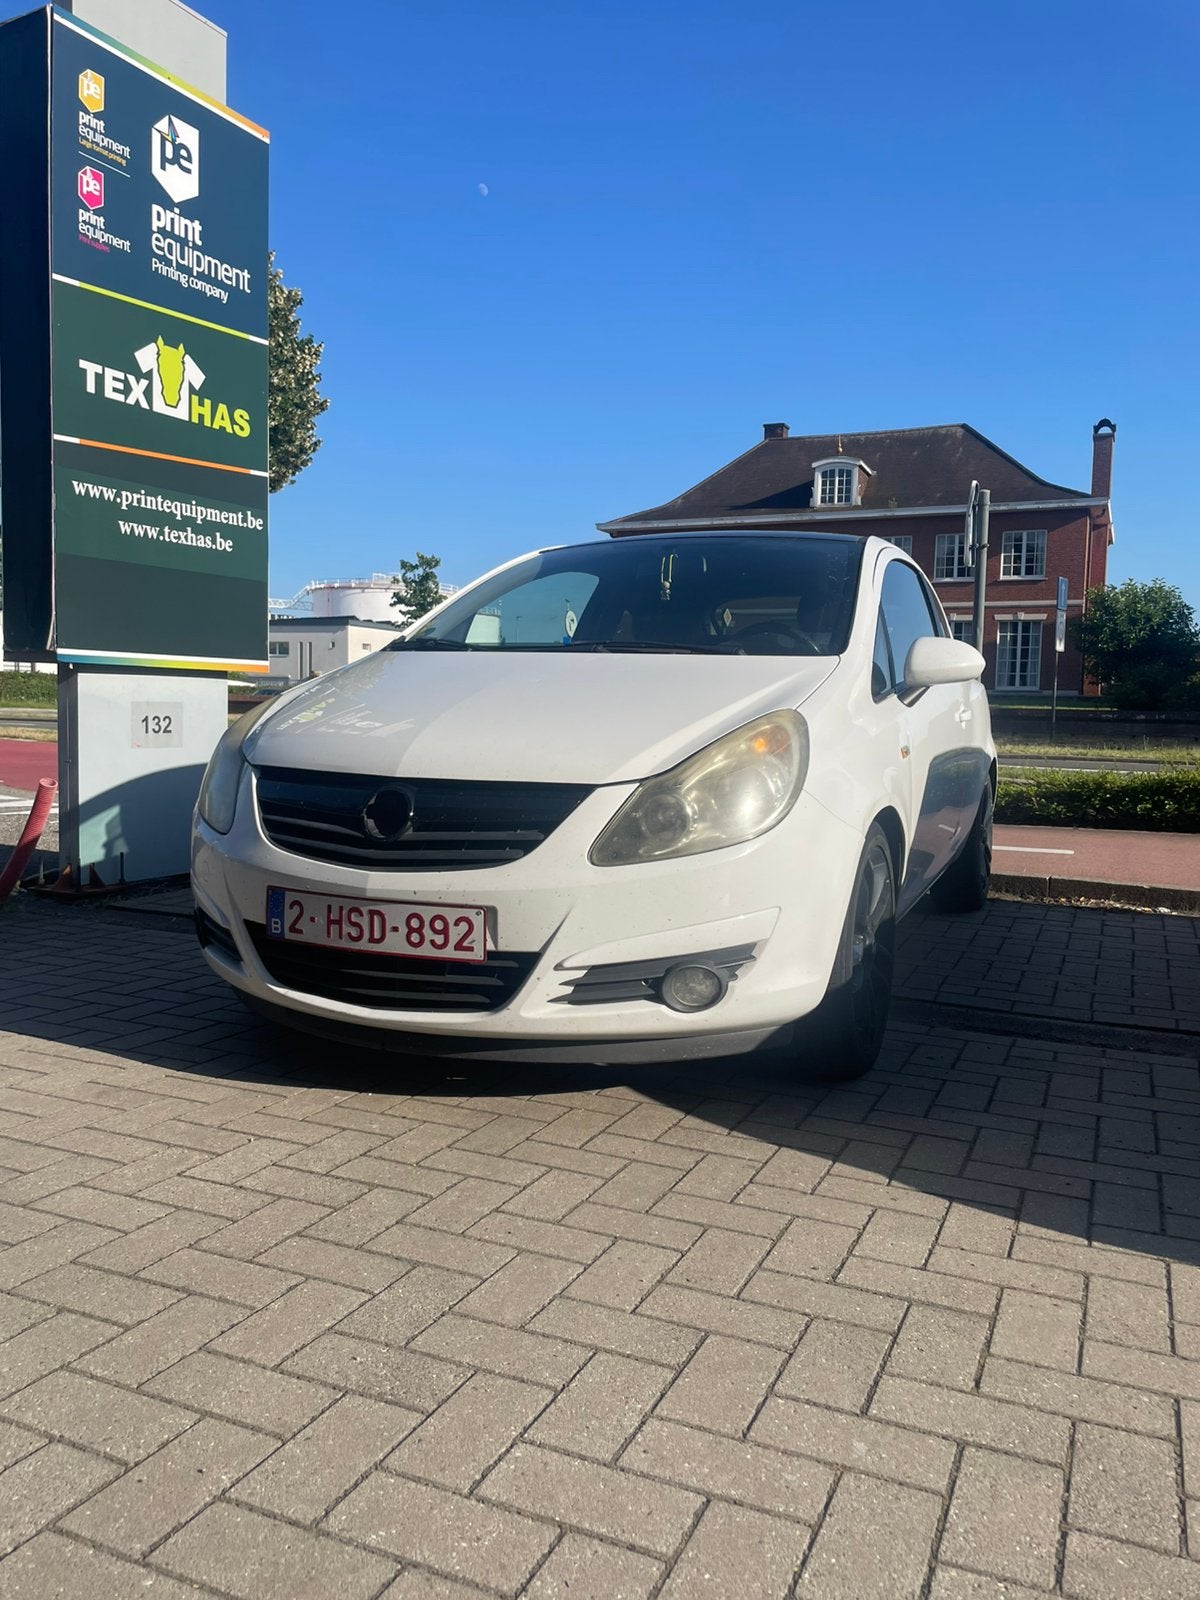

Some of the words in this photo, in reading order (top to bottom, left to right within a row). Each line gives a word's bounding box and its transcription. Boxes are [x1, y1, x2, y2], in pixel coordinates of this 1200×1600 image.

[79, 111, 105, 133] print
[79, 125, 131, 159] equipment
[160, 136, 193, 175] pe
[79, 208, 105, 230] print
[151, 203, 202, 246] print
[78, 222, 131, 253] equipment
[151, 232, 251, 294] equipment
[152, 257, 189, 288] Printing
[189, 276, 229, 304] company
[78, 358, 150, 410] TEX
[191, 394, 251, 438] HAS
[71, 480, 264, 530] www.printequipment.be
[118, 520, 234, 552] www.texhas.be
[141, 715, 173, 734] 132
[271, 918, 281, 934] B
